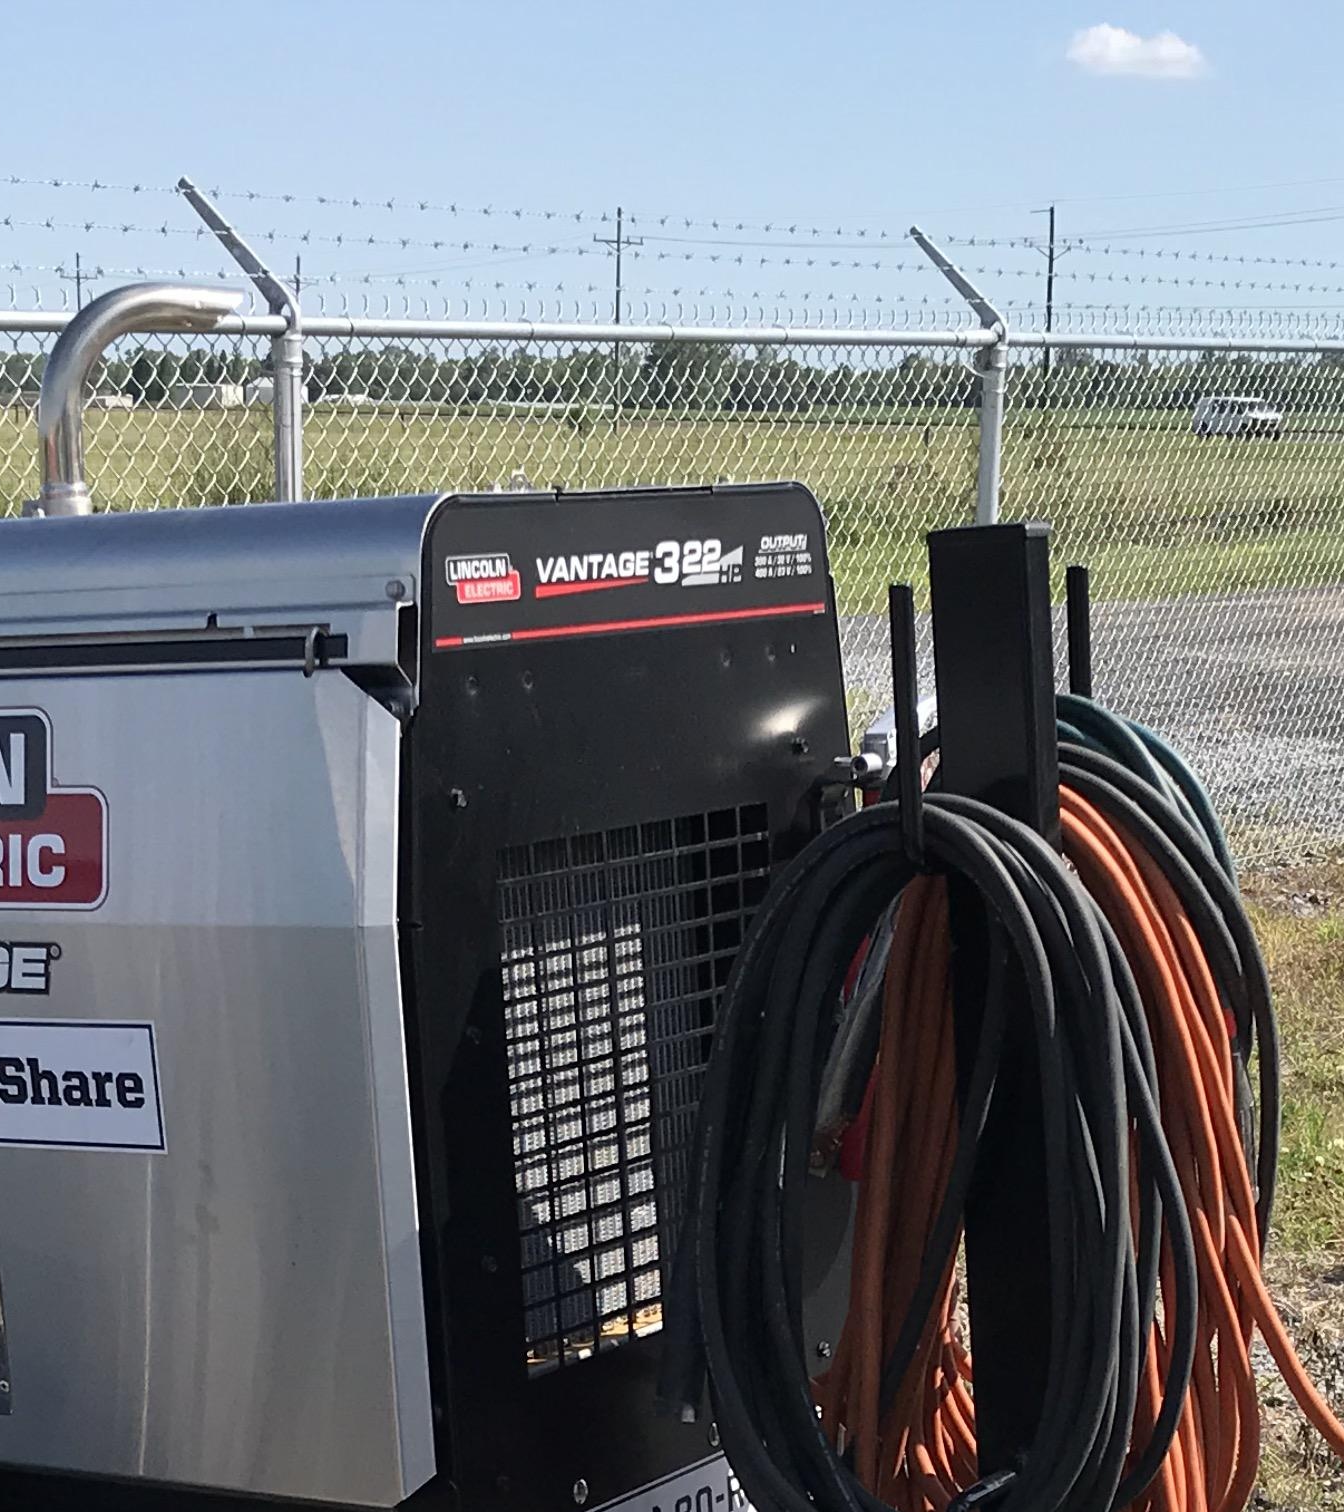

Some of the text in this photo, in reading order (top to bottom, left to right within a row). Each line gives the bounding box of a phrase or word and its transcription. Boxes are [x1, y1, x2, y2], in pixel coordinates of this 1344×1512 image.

[760, 534, 804, 550] OUTPUT
[450, 558, 507, 580] LINCOLN
[535, 550, 650, 584] VANTAGE
[654, 538, 721, 584] 322
[463, 580, 514, 599] ELECTRIC
